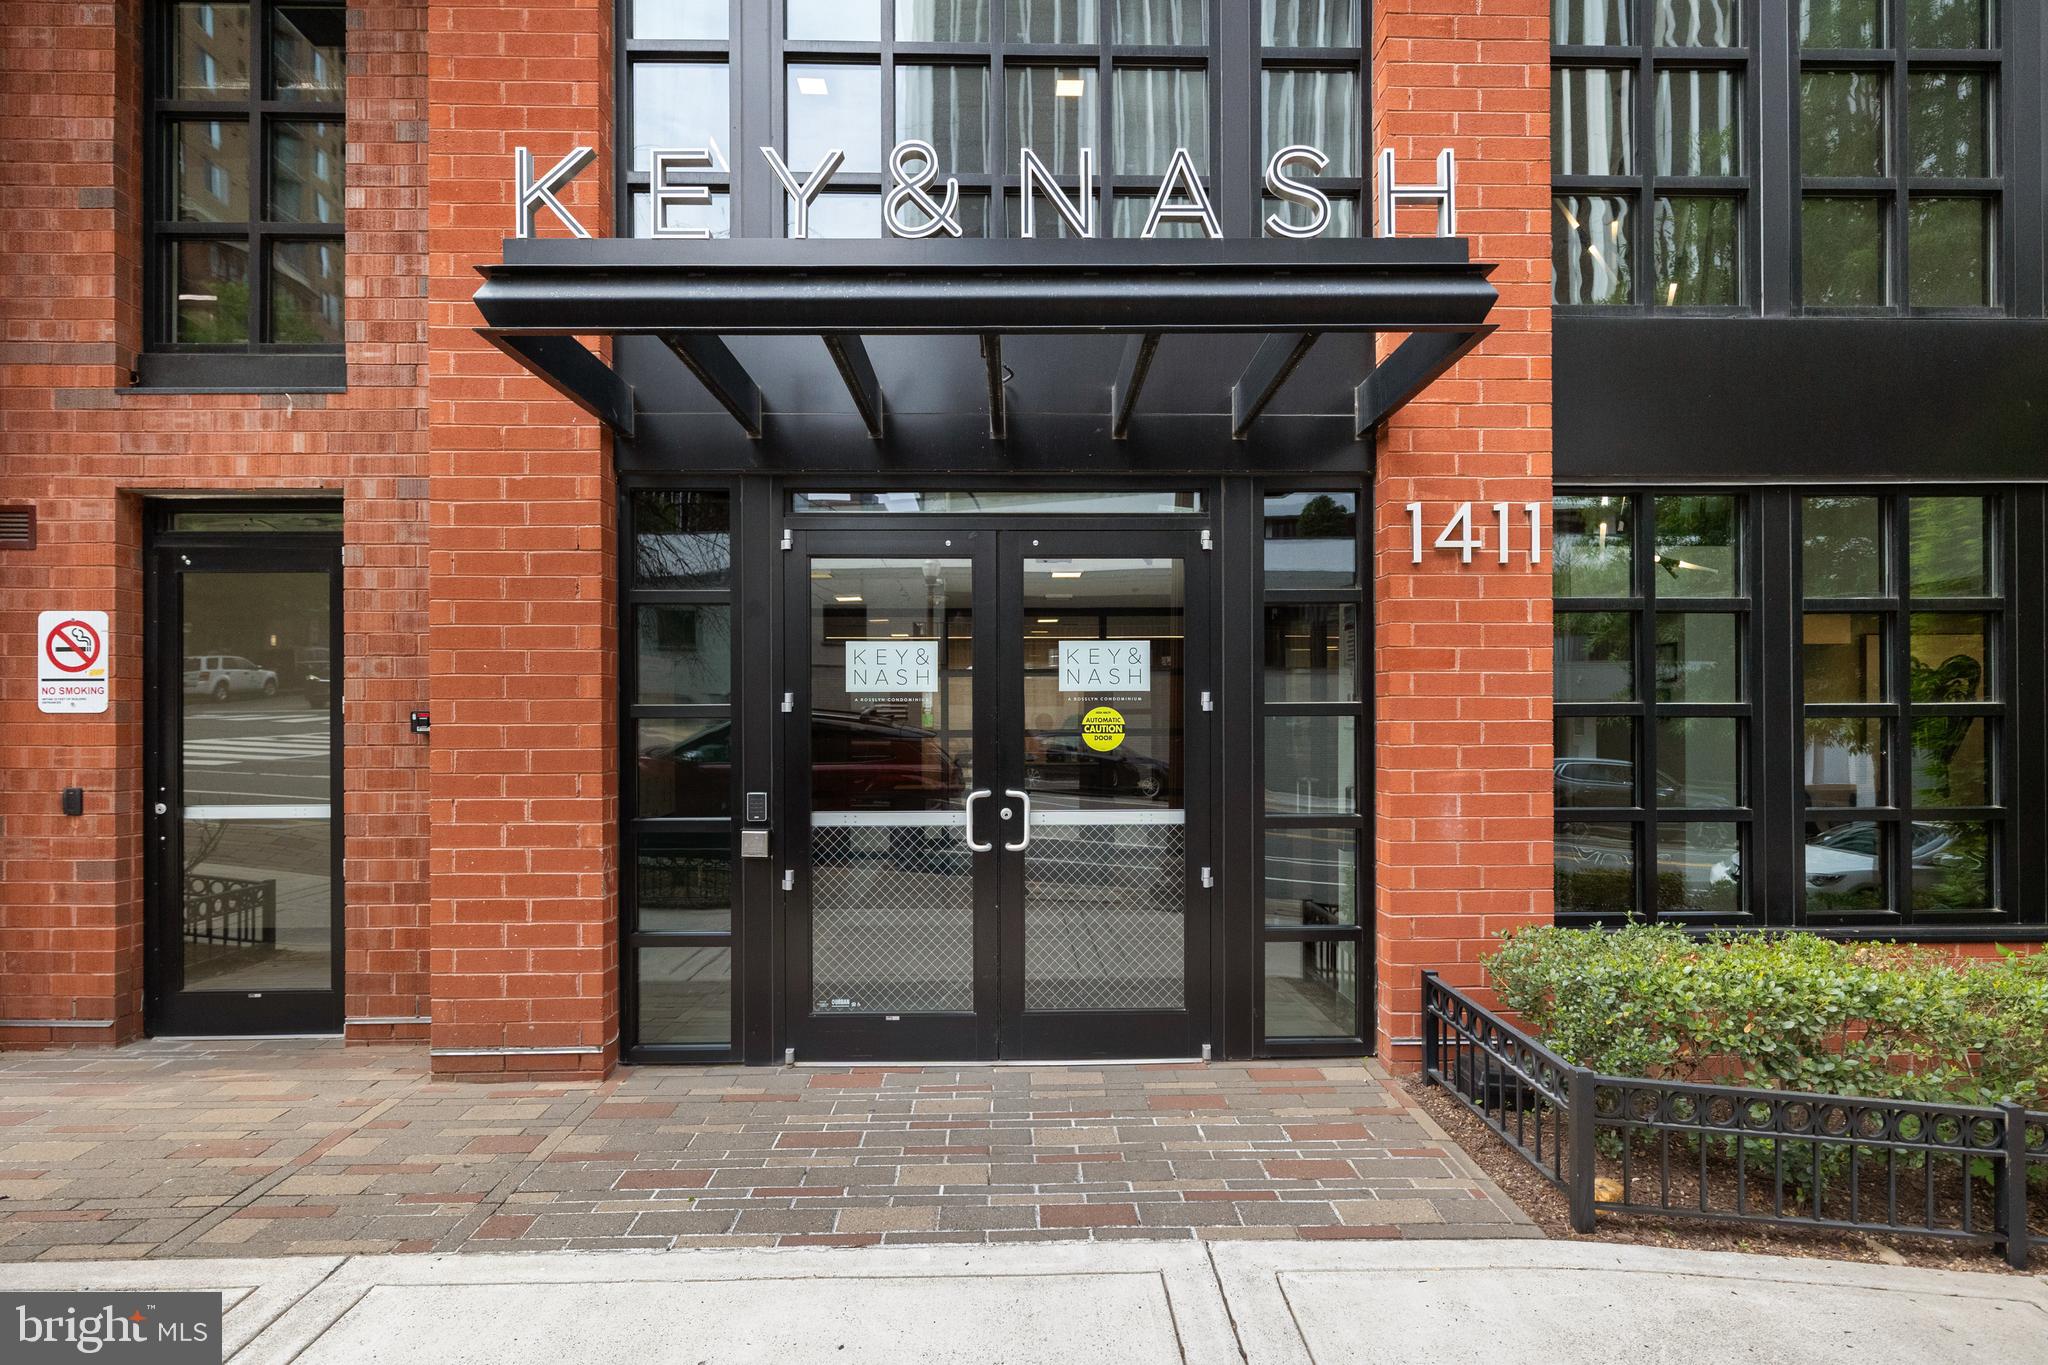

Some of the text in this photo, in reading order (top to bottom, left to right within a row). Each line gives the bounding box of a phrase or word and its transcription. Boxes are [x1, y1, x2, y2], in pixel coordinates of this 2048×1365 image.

[1405, 501, 1541, 564] 1411
[853, 647, 930, 666] KEY&
[1066, 646, 1142, 665] KEY&
[853, 668, 930, 686] NASH
[1066, 667, 1142, 685] NASH
[41, 686, 105, 695] NO SMOKING
[1083, 725, 1123, 733] CAUTION
